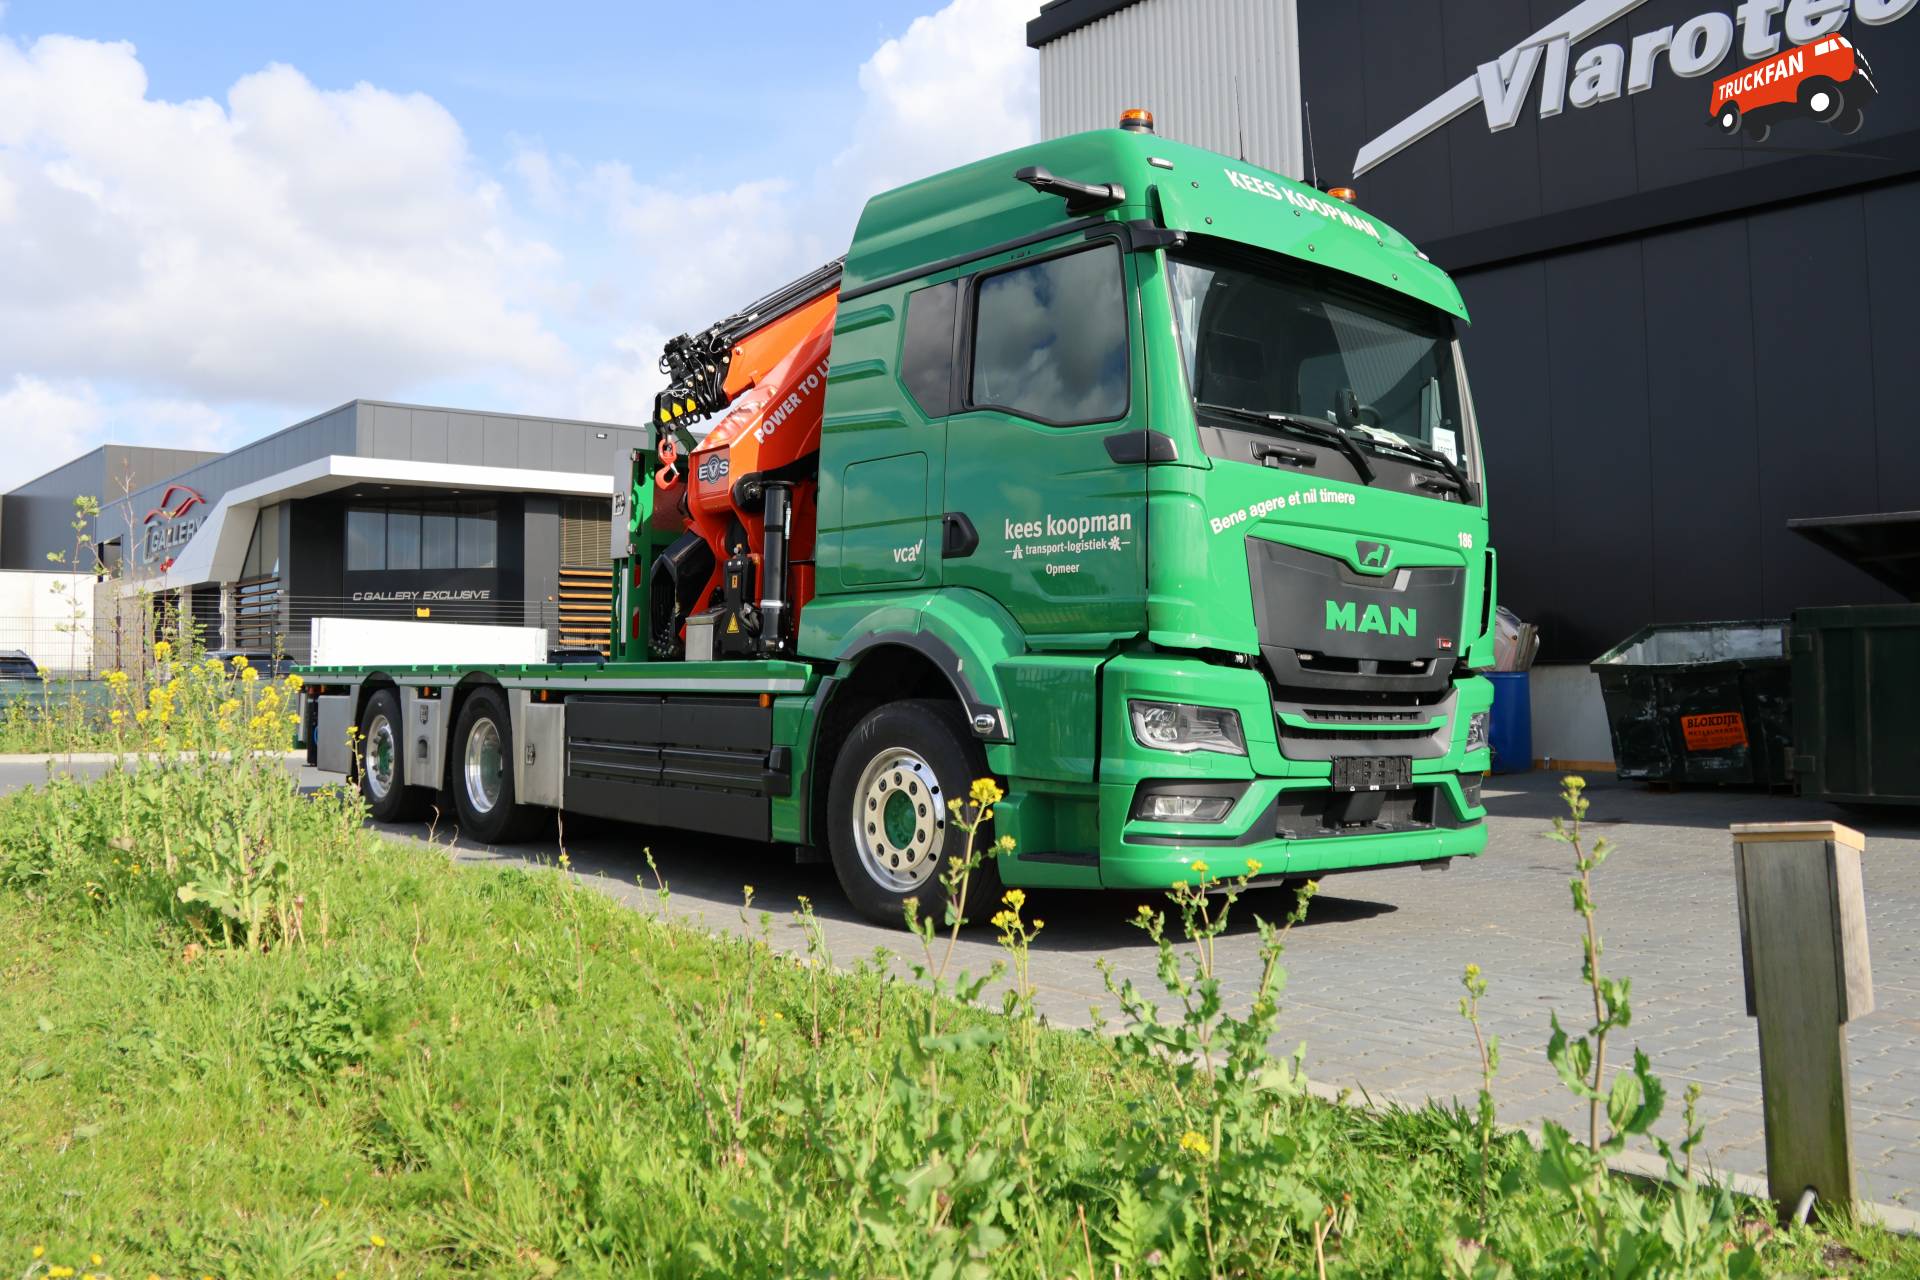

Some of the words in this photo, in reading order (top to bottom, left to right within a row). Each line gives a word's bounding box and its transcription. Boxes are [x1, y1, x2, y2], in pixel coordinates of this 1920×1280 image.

[1223, 168, 1283, 201] KEES
[1281, 186, 1381, 240] KOOPMAN
[753, 392, 802, 444] POWER
[798, 374, 819, 396] TO
[1210, 508, 1247, 535] Bene
[1249, 496, 1286, 518] agere
[1288, 490, 1301, 506] et
[1303, 488, 1318, 504] nil
[1320, 488, 1356, 505] timere
[1005, 518, 1042, 540] kees
[1047, 512, 1132, 540] koopman
[1025, 538, 1108, 556] transport-logistiek
[1457, 531, 1473, 550] 186
[893, 545, 918, 563] vca
[1045, 563, 1080, 577] Opmeer
[352, 592, 363, 601] C
[364, 591, 419, 601] GALLERY
[422, 590, 491, 600] EXCLUSIVE
[1325, 599, 1418, 637] MAN
[1687, 714, 1739, 729] BLOKDIJK
